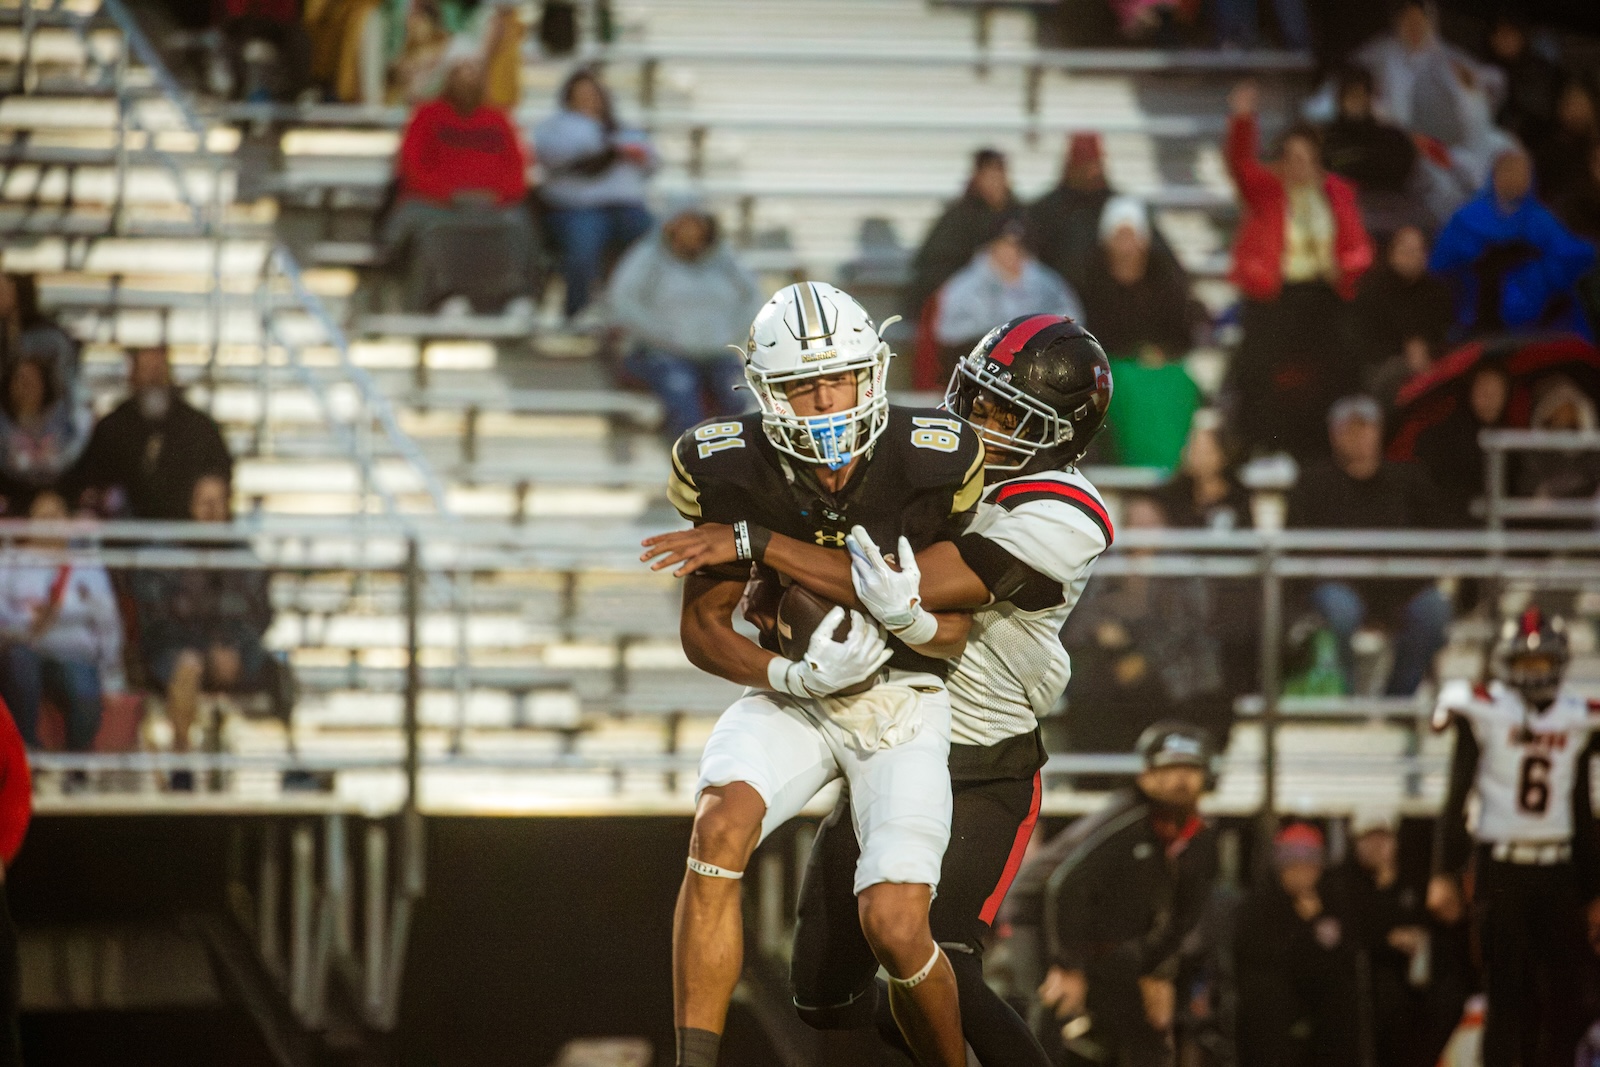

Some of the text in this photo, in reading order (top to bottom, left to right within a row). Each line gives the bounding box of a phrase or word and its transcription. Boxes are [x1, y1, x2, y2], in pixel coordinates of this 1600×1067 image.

[987, 362, 1000, 374] F7
[694, 421, 746, 459] 81
[910, 416, 962, 453] 81
[1515, 755, 1553, 818] 6
